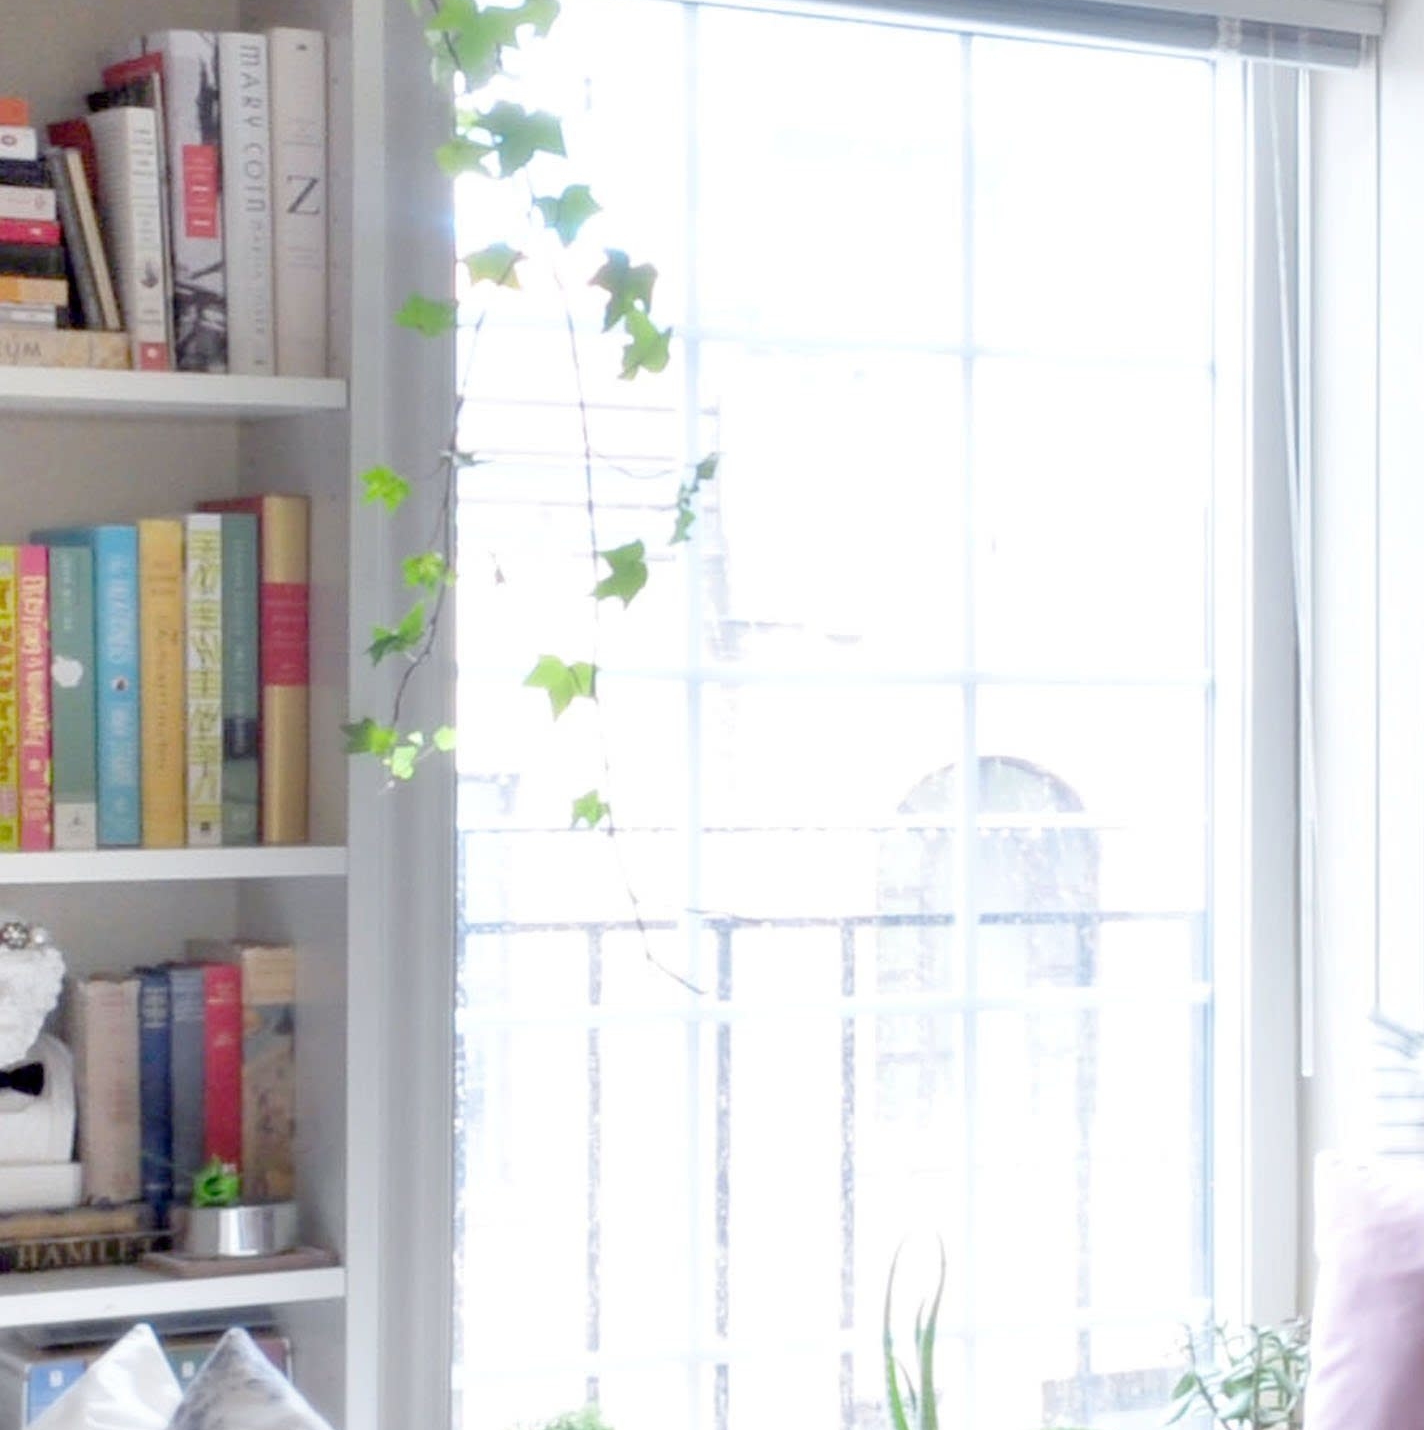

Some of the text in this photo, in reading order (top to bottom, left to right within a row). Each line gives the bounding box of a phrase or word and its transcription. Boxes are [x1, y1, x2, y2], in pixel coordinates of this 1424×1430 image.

[239, 44, 262, 128] MARY
[244, 142, 266, 213] COIN
[286, 174, 321, 215] Z
